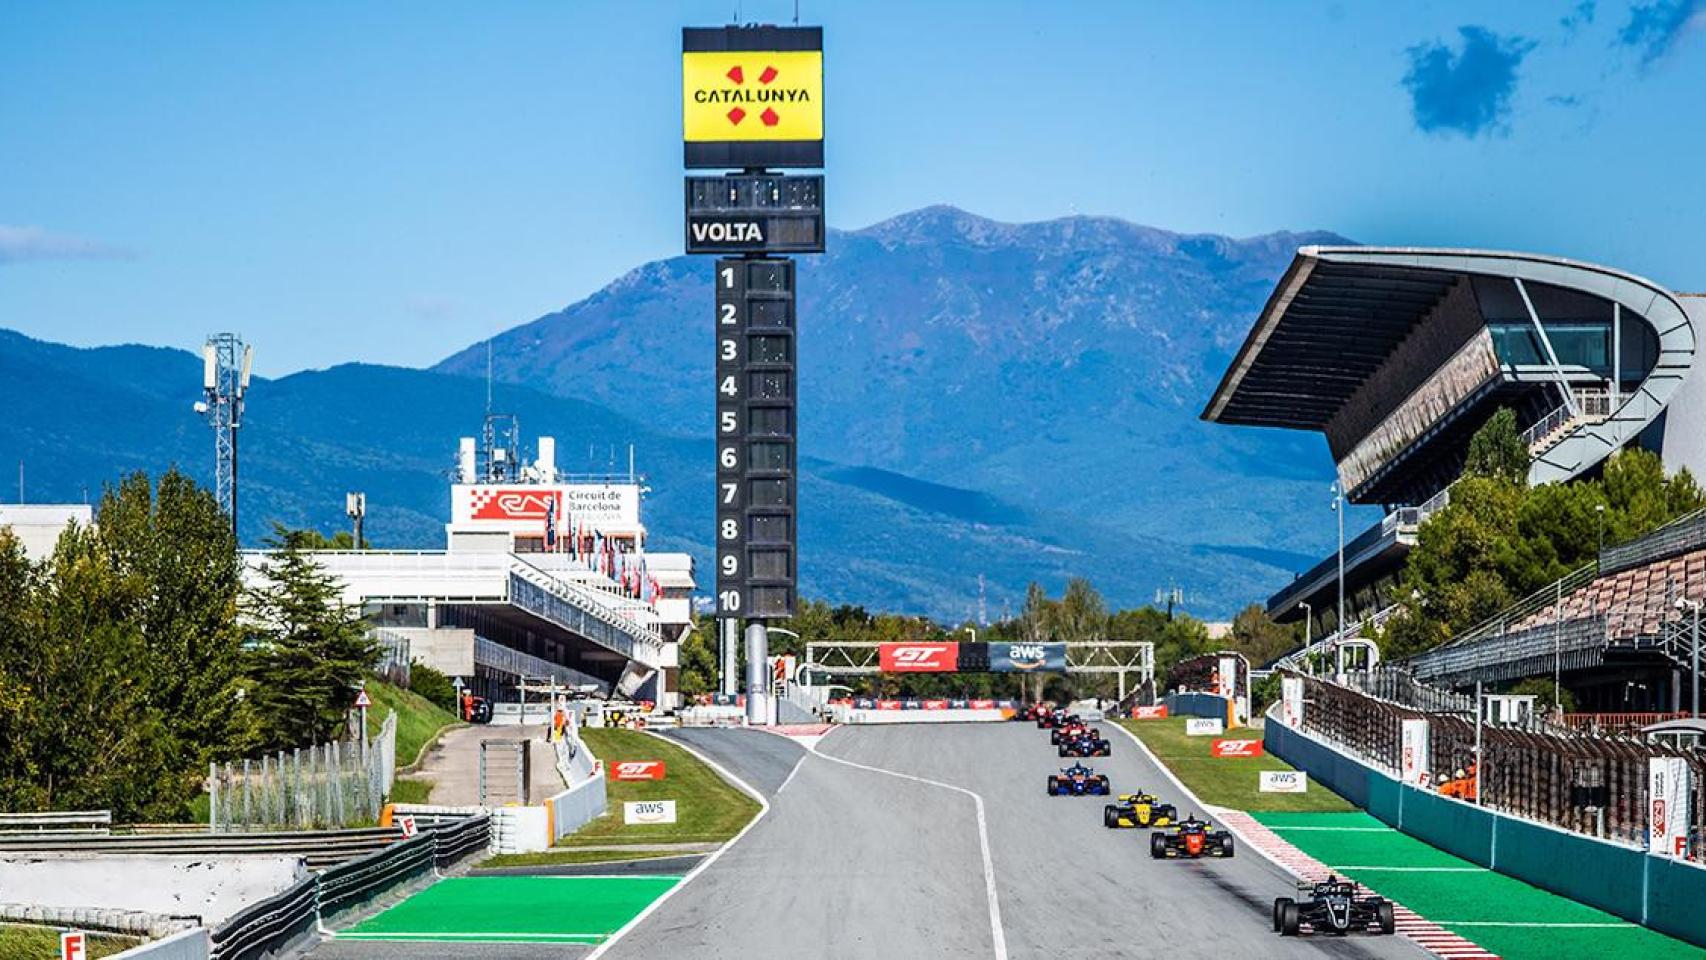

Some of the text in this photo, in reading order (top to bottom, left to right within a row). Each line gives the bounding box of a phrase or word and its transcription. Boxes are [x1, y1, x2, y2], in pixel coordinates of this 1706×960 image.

[694, 89, 810, 103] CATALUNYA
[692, 223, 763, 242] VOLTA
[721, 268, 734, 288] 1
[721, 304, 737, 325] 2
[721, 340, 737, 361] 3
[720, 376, 737, 396] 4
[721, 412, 737, 432] 5
[721, 448, 737, 468] 6
[569, 490, 621, 500] Circuit de
[721, 483, 737, 504] 7
[569, 501, 622, 511] Barcelona
[721, 519, 737, 540] 8
[722, 555, 737, 575] 9
[719, 591, 740, 611] 10
[891, 647, 947, 661] GT
[1010, 645, 1044, 659] aws
[1270, 773, 1297, 783] aws
[635, 802, 664, 814] aws
[403, 818, 414, 833] F
[1675, 836, 1687, 855] F
[65, 936, 81, 960] F
